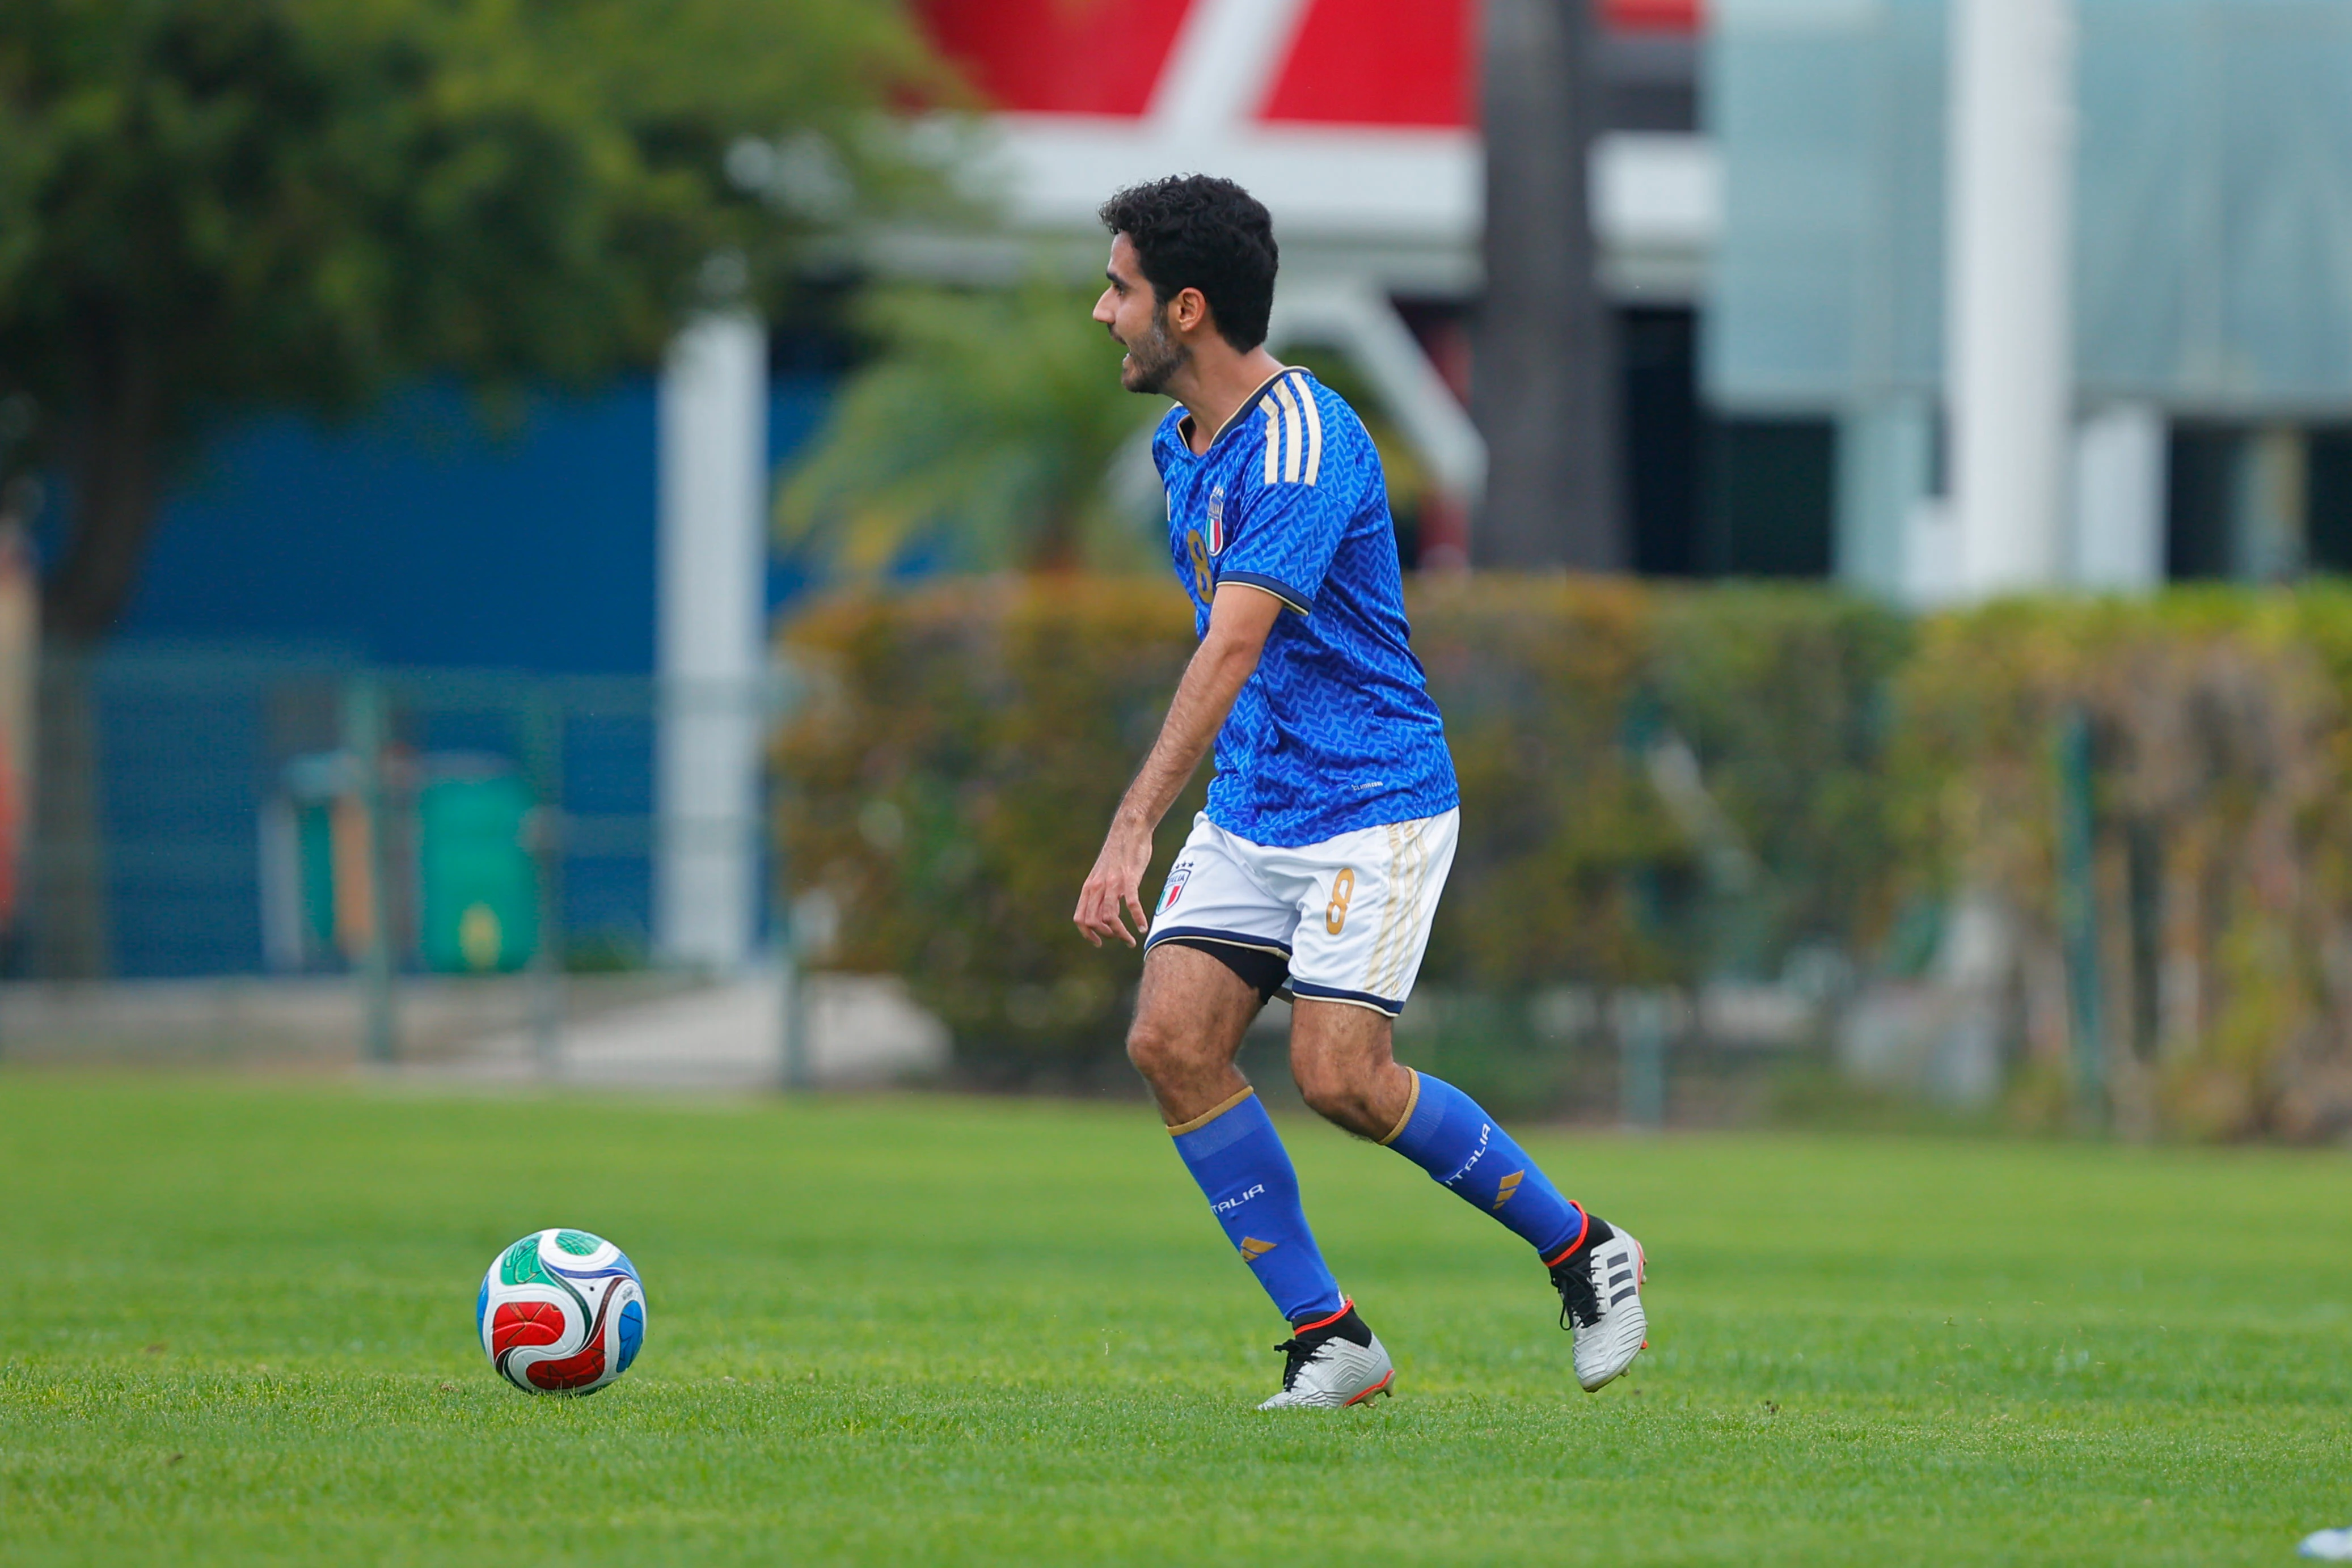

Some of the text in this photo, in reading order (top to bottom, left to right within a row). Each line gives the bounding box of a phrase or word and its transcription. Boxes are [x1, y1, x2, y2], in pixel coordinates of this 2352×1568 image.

[1187, 529, 1213, 604] 8
[1326, 868, 1355, 935] 8
[1445, 1123, 1490, 1186] ITALIA
[1211, 1184, 1265, 1214] TALIA
